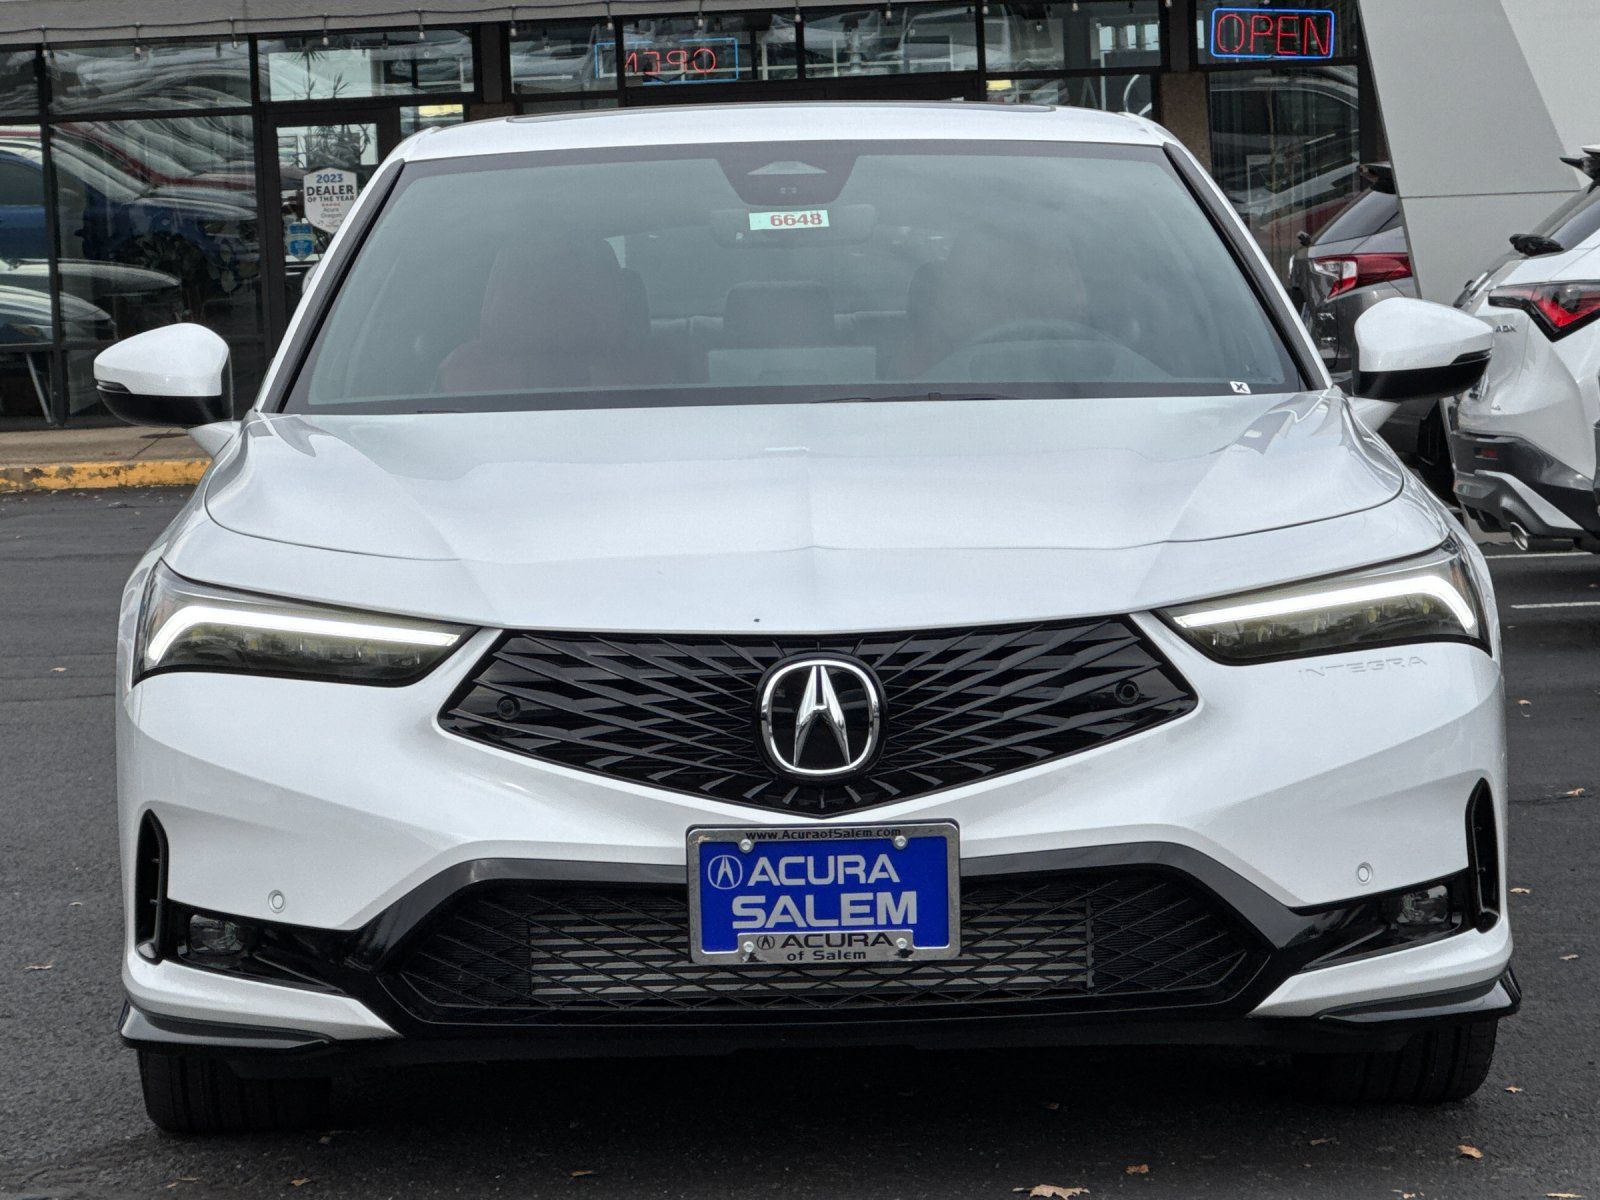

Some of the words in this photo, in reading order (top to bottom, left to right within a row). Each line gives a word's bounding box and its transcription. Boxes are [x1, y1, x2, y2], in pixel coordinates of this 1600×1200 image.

[1217, 13, 1330, 55] OPEN
[316, 173, 343, 183] 2023
[306, 185, 354, 196] DEALER
[770, 213, 823, 227] 6648
[1298, 656, 1427, 677] INTEGRA
[747, 854, 900, 886] ACURA
[732, 891, 918, 929] SALEM
[780, 933, 894, 949] ACURA
[787, 951, 804, 961] of
[813, 950, 866, 961] Salem
